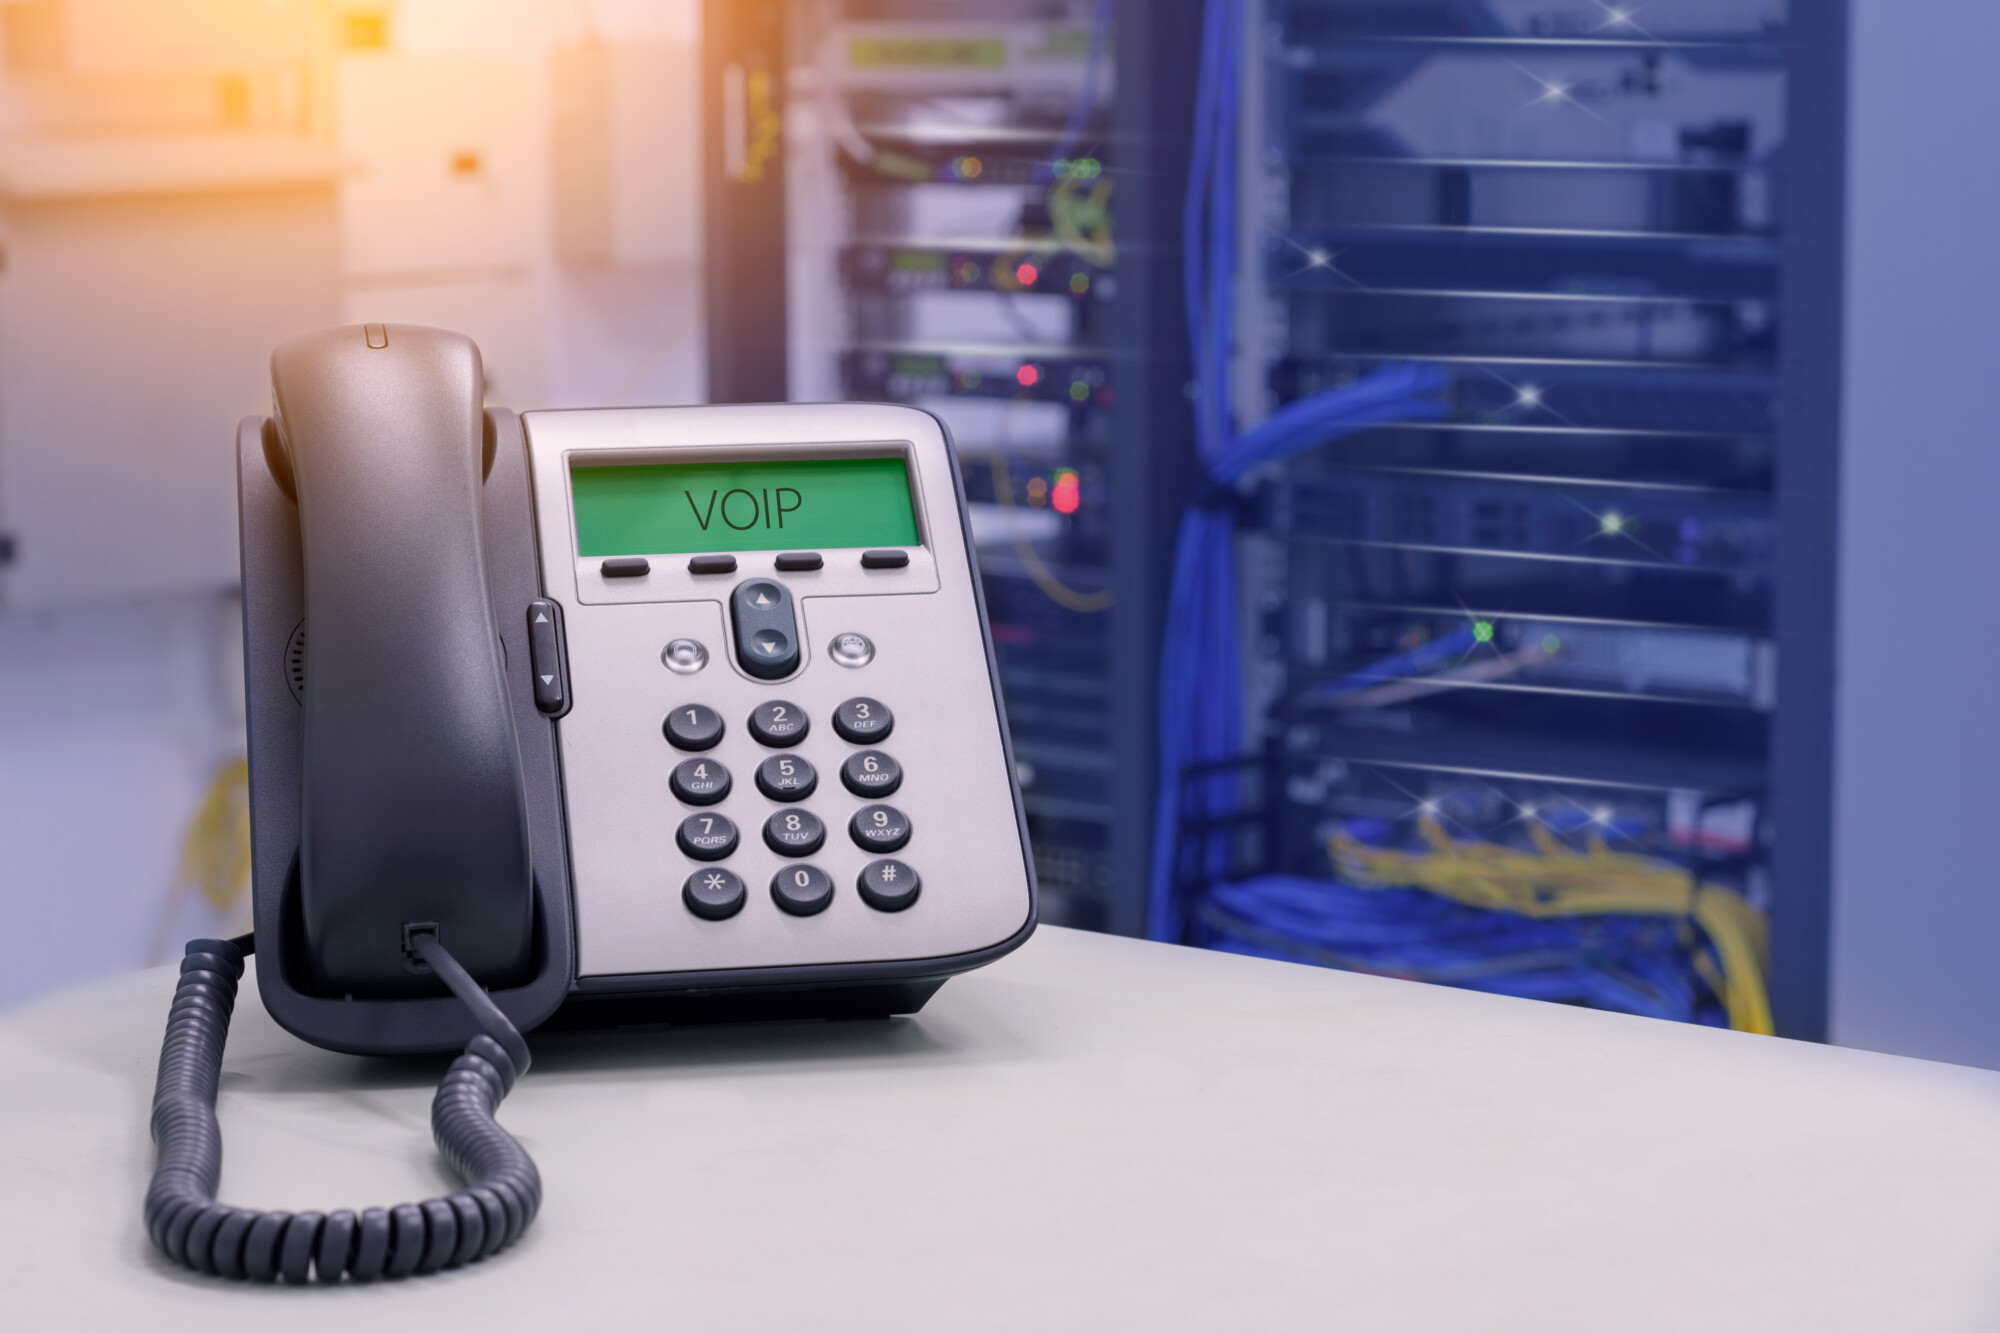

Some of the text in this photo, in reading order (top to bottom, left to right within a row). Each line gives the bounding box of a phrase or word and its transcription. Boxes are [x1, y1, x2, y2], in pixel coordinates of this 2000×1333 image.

[685, 487, 802, 531] VOIP
[686, 709, 698, 725] 1
[772, 706, 788, 722] 2
[855, 703, 870, 719] 3
[769, 723, 794, 732] ABC
[854, 720, 876, 729] DEF
[693, 763, 708, 779] 4
[779, 759, 795, 776] 5
[863, 756, 879, 772] 6
[691, 781, 713, 790] GHI
[778, 777, 800, 786] JKL
[859, 773, 889, 782] MNO
[699, 818, 714, 834] 7
[784, 815, 802, 831] 8
[872, 811, 888, 827] 9
[693, 835, 727, 845] PQRS
[783, 832, 809, 841] TUV
[865, 828, 900, 837] WXYZ
[794, 870, 810, 887] 0
